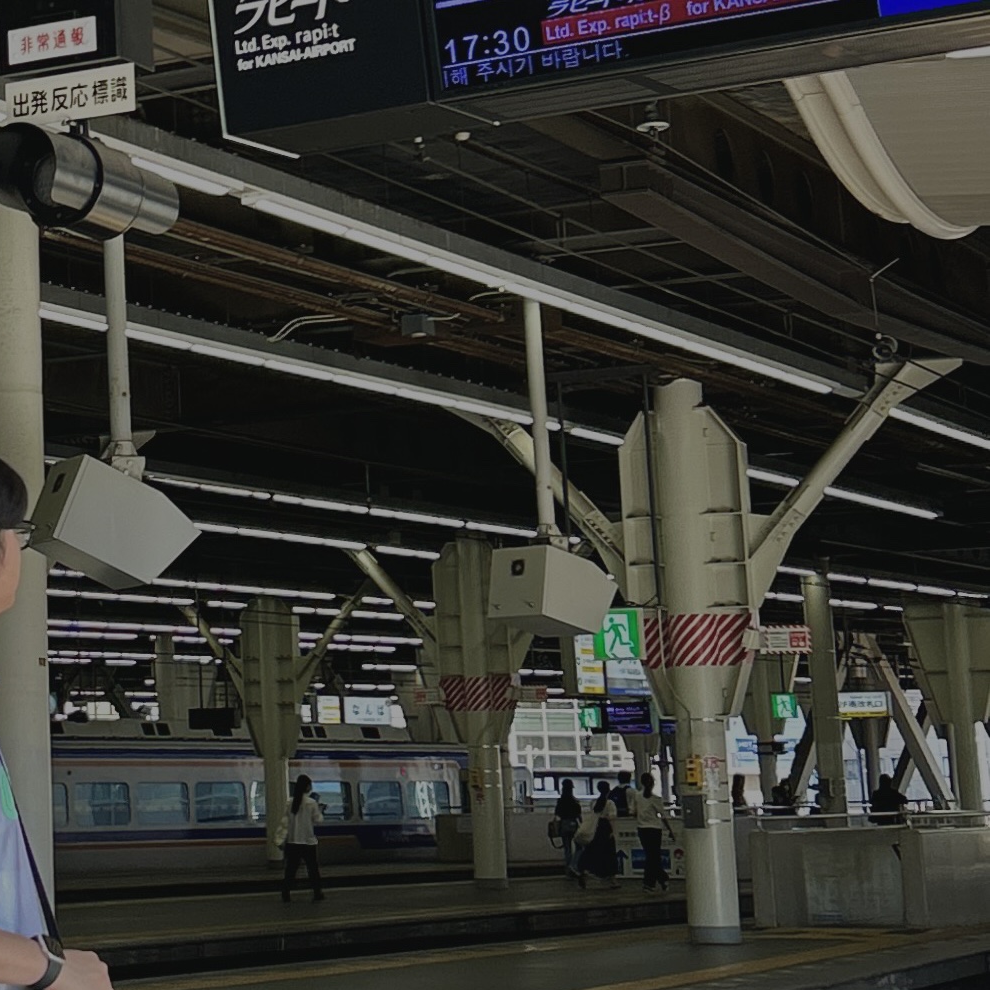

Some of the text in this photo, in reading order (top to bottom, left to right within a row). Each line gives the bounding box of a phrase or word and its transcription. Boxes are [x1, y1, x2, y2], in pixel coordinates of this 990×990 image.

[545, 23, 574, 41] Ltd.
[577, 18, 612, 36] Exp.
[686, 2, 709, 16] for
[20, 26, 85, 56] 非常通報
[234, 22, 340, 55] Ltd. Exp. rapi:t
[444, 26, 531, 63] 17:30
[237, 58, 255, 71] for
[443, 66, 469, 88] 해
[476, 55, 534, 83] 주시기
[13, 76, 129, 118] 出発反応標識
